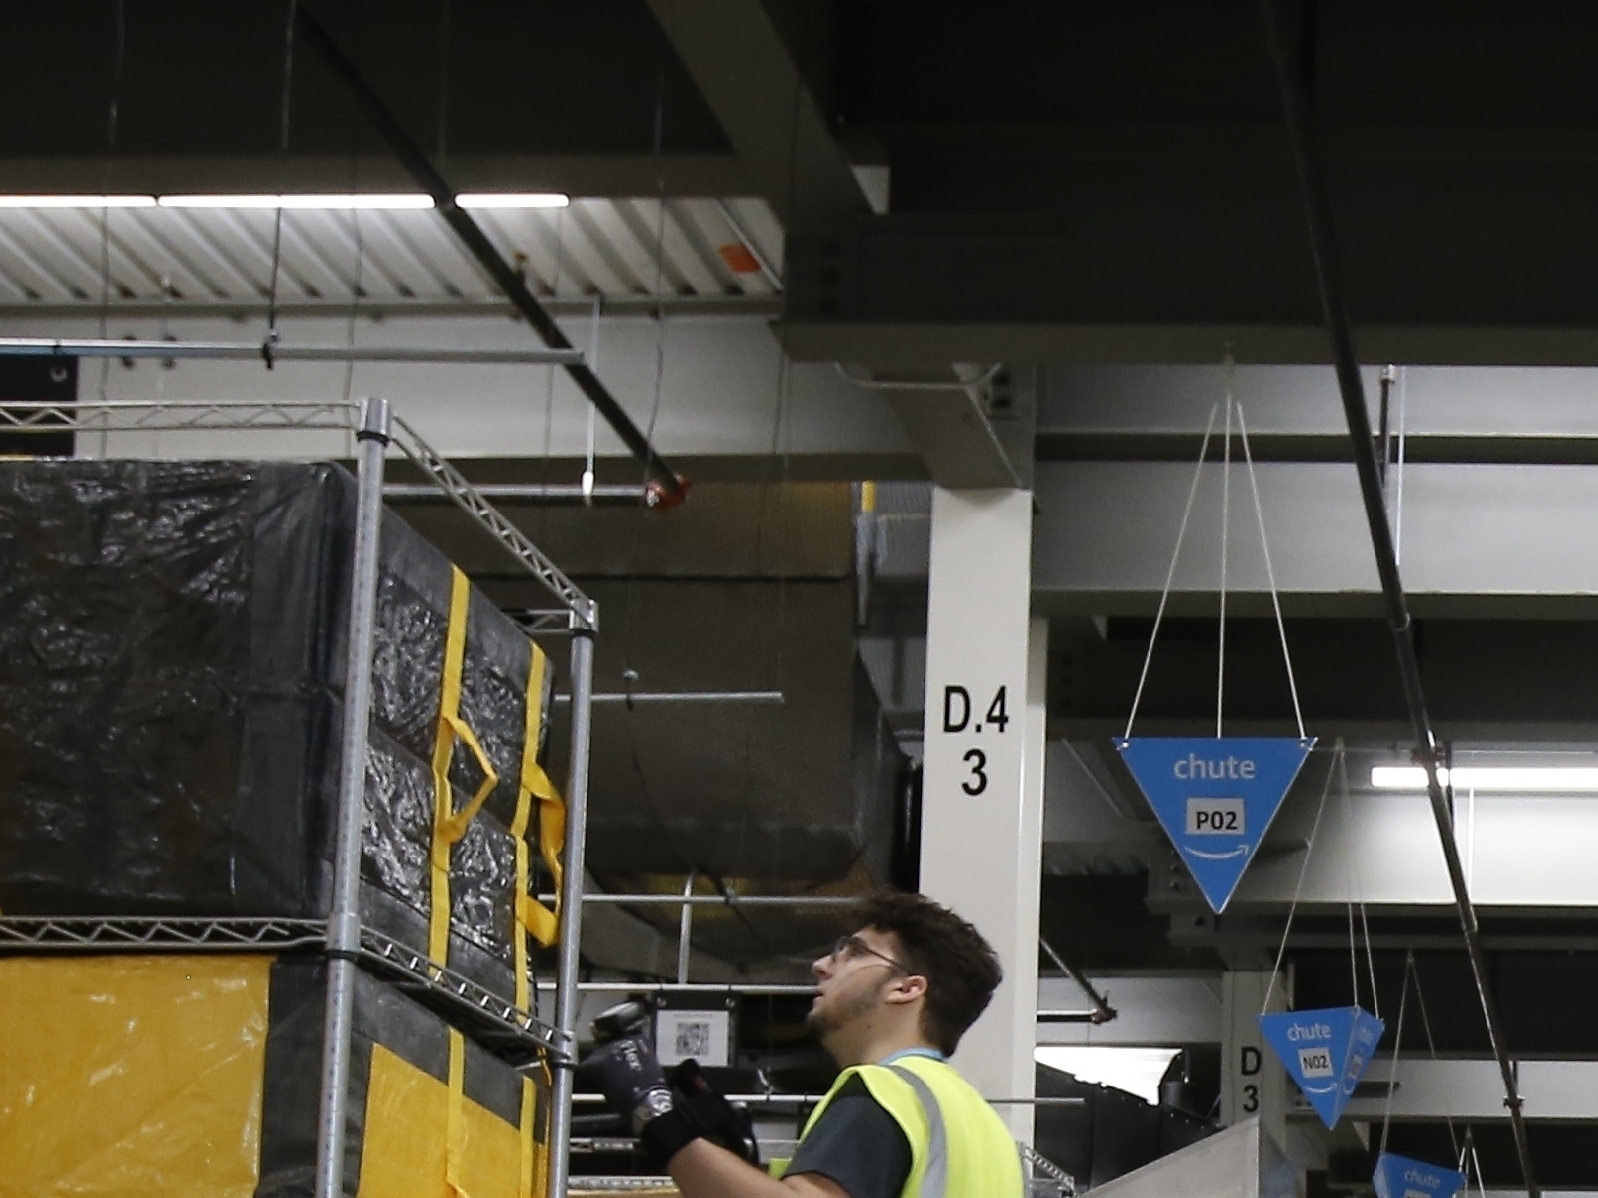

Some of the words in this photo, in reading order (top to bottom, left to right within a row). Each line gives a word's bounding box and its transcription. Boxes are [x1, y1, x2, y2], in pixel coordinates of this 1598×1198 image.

[943, 685, 1009, 733] D.4
[962, 748, 987, 796] 3
[1173, 751, 1256, 779] chute
[1195, 810, 1239, 831] P02
[1286, 1022, 1332, 1041] chute
[1241, 1046, 1261, 1076] D
[1243, 1085, 1259, 1113] 3
